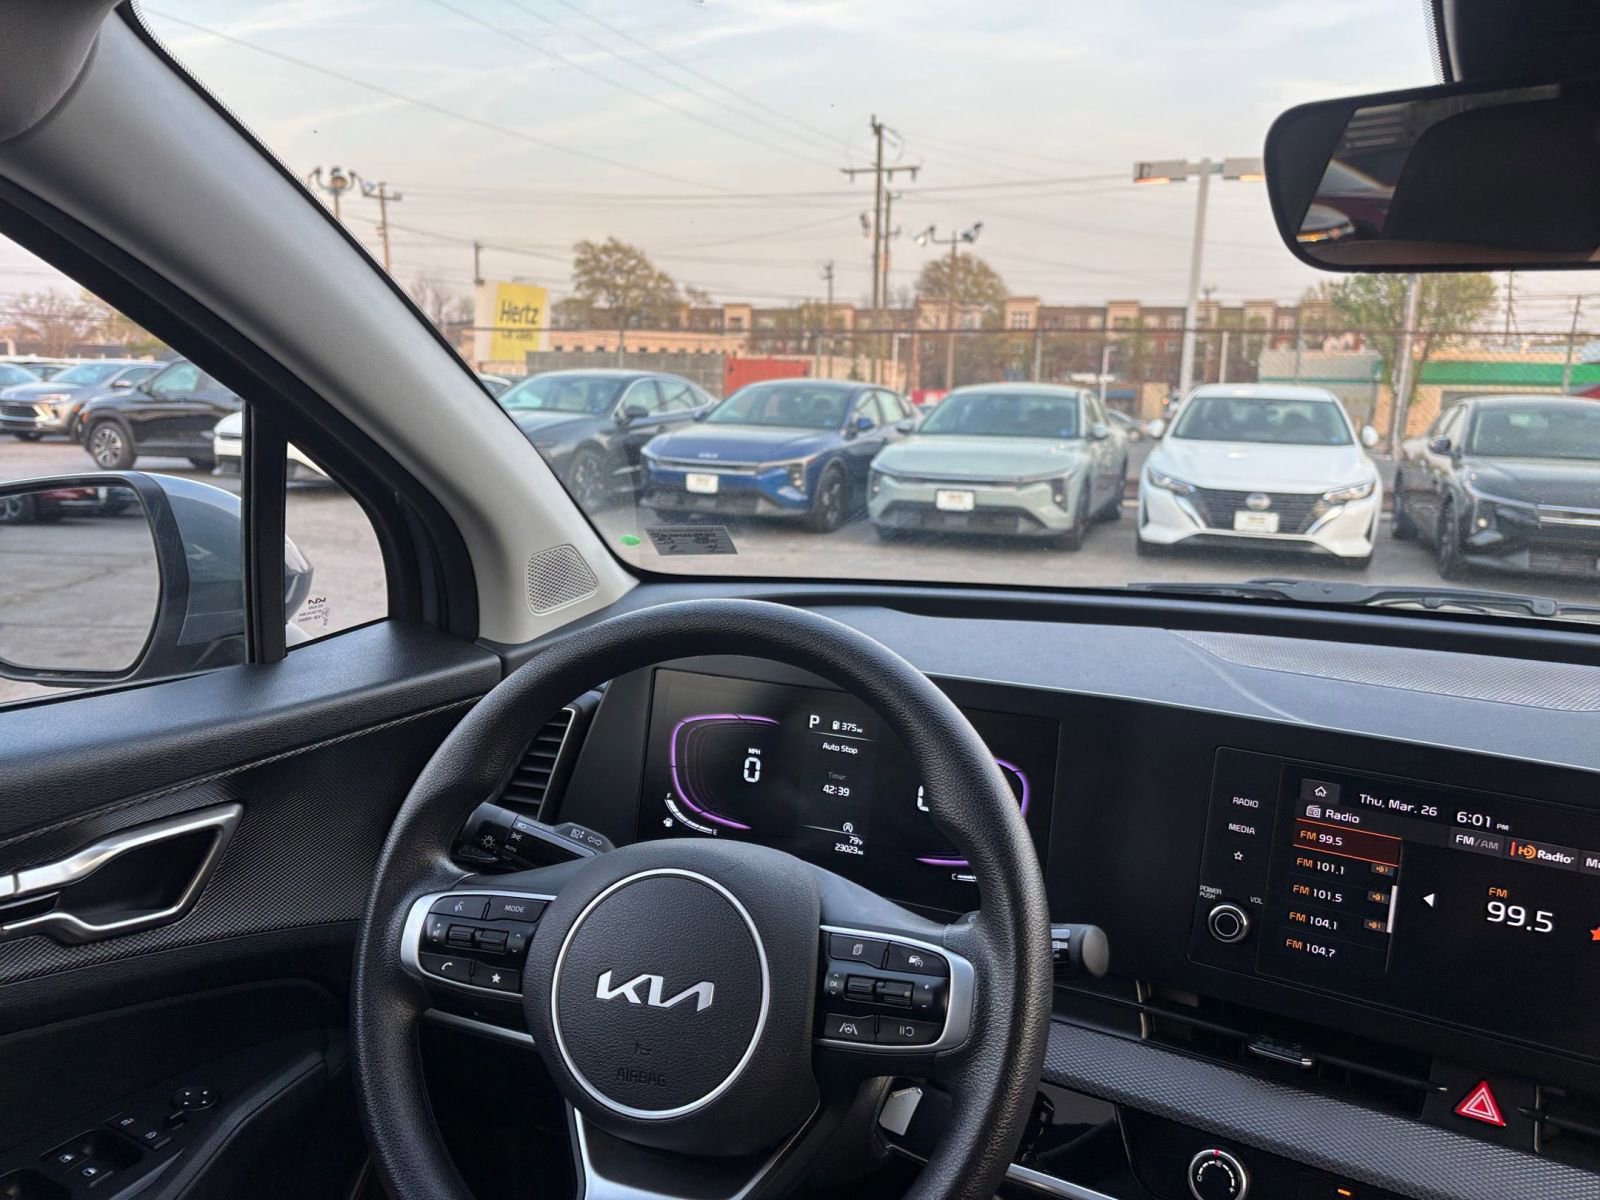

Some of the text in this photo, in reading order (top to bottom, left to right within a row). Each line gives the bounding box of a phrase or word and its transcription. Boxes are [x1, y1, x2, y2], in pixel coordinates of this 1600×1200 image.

[499, 300, 539, 325] Hertz
[808, 714, 820, 729] P
[747, 747, 761, 755] MPH
[822, 742, 858, 755] Auto Stop
[743, 757, 761, 783] 0
[822, 784, 850, 797] 42:39
[1232, 796, 1259, 808] RADIO
[1359, 793, 1439, 817] Thu. Mar. 26
[1325, 808, 1360, 824] Radio
[1456, 811, 1510, 831] 6:01 PM
[712, 828, 718, 836] E
[1228, 822, 1256, 835] MEDIA
[1299, 830, 1343, 847] FM 99.5
[1455, 834, 1499, 850] FM/AM
[1537, 849, 1571, 864] Radio
[1296, 857, 1345, 876] FM 101.1
[1200, 884, 1222, 896] POWER
[1200, 890, 1216, 900] PUSH
[1292, 884, 1343, 904] FM 101.5
[1488, 886, 1508, 899] FM
[1249, 895, 1263, 905] VOL
[504, 904, 526, 914] MODE
[1486, 900, 1554, 933] 99.5
[1289, 911, 1338, 931] FM 104.1
[1285, 938, 1337, 959] FM 104.7
[596, 970, 715, 1013] KIA
[616, 1068, 666, 1088] AIRBAG
